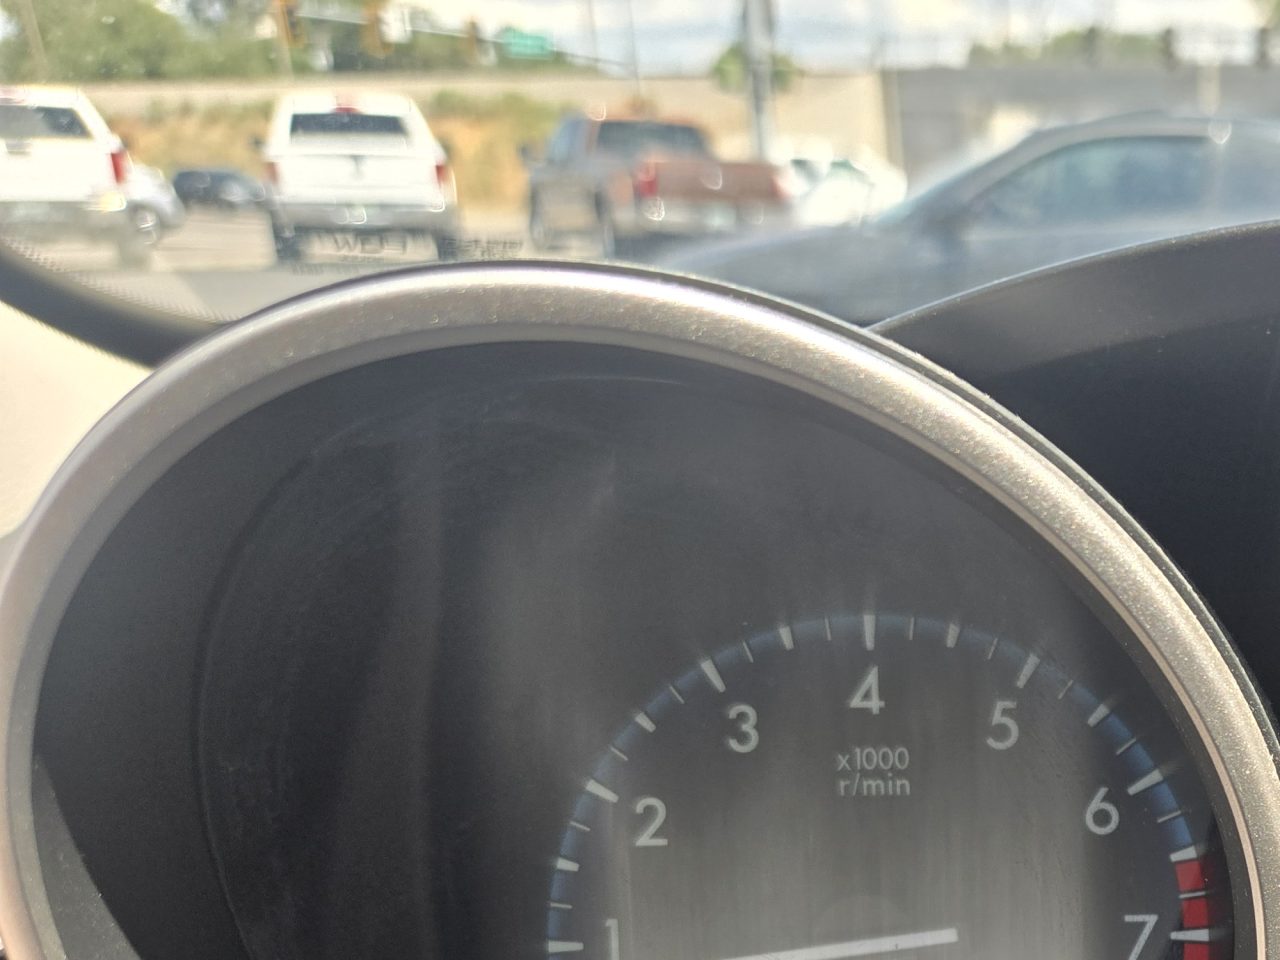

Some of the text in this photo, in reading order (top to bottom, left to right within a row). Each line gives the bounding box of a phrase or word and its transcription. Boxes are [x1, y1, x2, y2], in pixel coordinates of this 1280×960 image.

[849, 667, 885, 715] 4
[727, 703, 760, 754] 3
[986, 702, 1020, 750] 5
[837, 747, 909, 771] x1000
[838, 772, 911, 797] r/min
[635, 797, 668, 847] 2
[1086, 787, 1119, 835] 6
